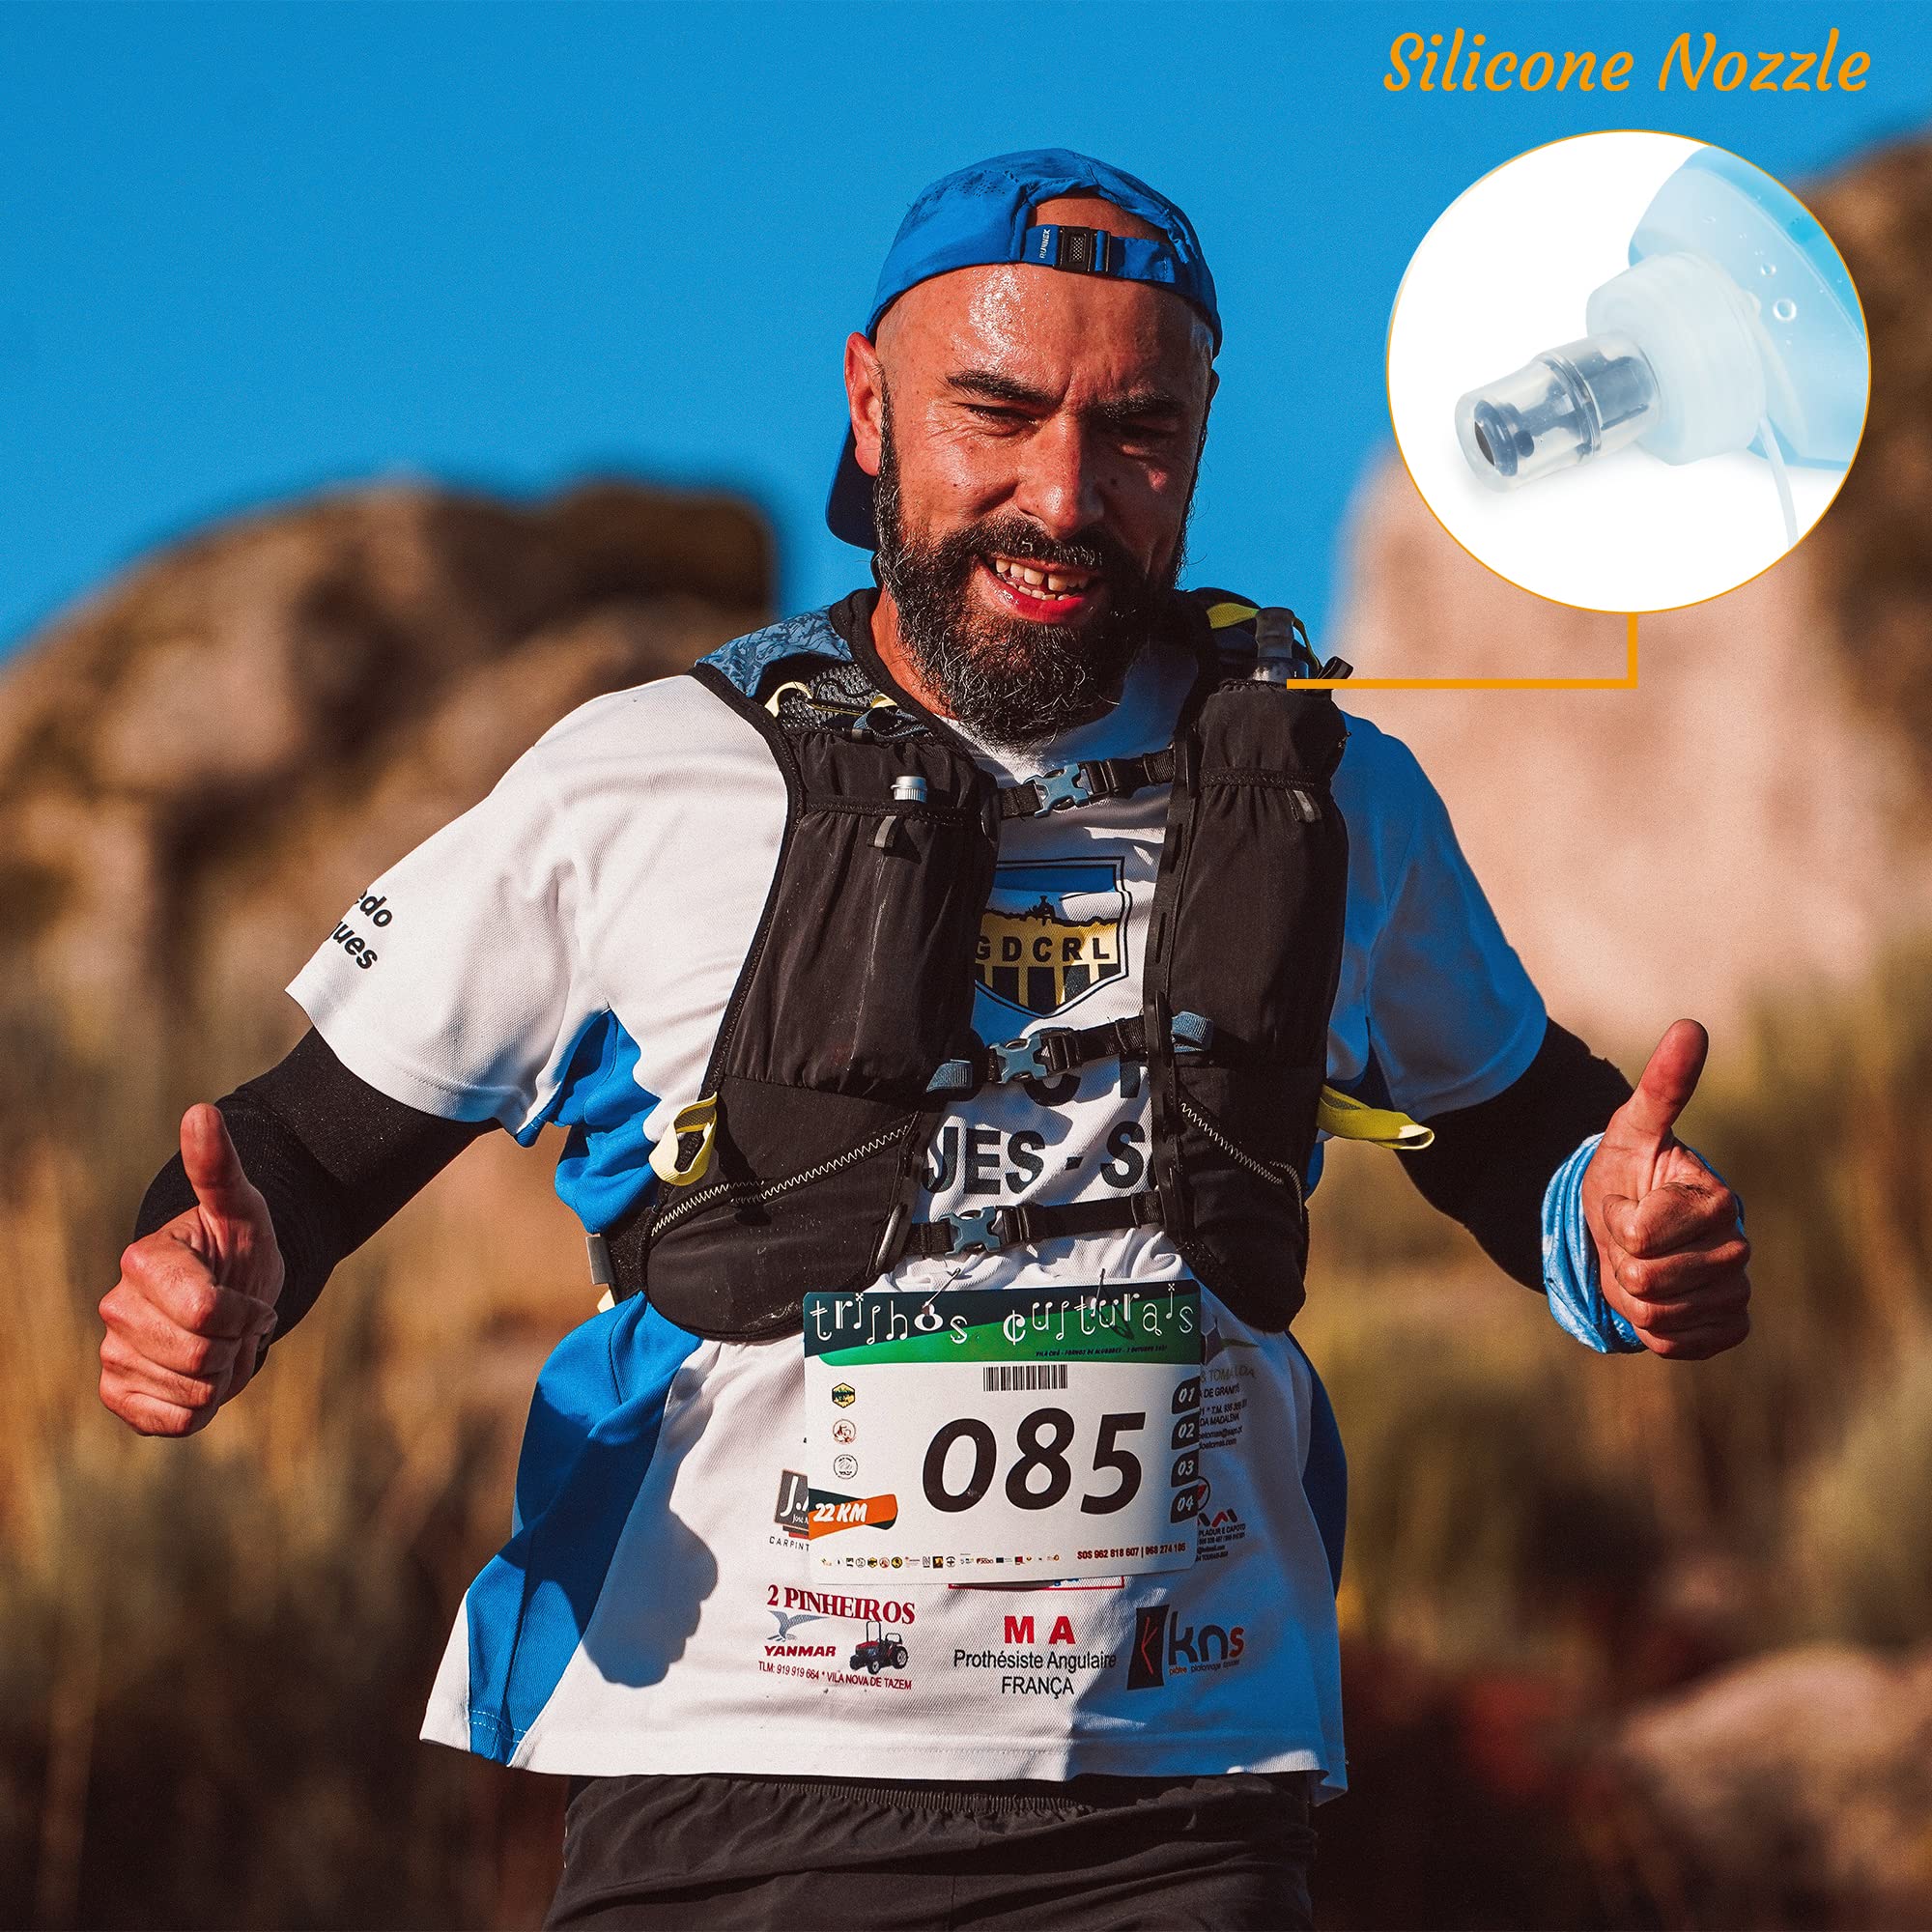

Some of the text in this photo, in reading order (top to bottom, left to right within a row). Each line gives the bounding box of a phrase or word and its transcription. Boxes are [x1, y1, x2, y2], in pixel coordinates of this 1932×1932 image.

[1100, 1121, 1158, 1189] S
[1178, 1386, 1196, 1404] 01
[1178, 1422, 1196, 1439] 02
[923, 1407, 1147, 1516] 085
[1178, 1460, 1195, 1477] 03
[812, 1502, 868, 1523] 22 KM
[1177, 1495, 1195, 1512] 04
[1077, 1549, 1093, 1560] SOS
[1094, 1548, 1109, 1559] 962
[1110, 1548, 1124, 1558] 818
[1125, 1547, 1140, 1557] 607
[1159, 1544, 1173, 1555] 274
[767, 1584, 916, 1625] 2 PINHEIROS
[1004, 1615, 1077, 1645] M A
[1167, 1610, 1245, 1666] kns
[764, 1645, 837, 1658] YANMAR
[953, 1648, 1118, 1675] Prothésiste Angulaire
[776, 1663, 791, 1676] 919
[790, 1665, 805, 1679] 919
[806, 1668, 820, 1681] 664
[827, 1671, 844, 1685] VILA
[845, 1675, 869, 1687] NOVA
[869, 1676, 882, 1689] DE
[883, 1677, 913, 1690] TAZEM
[1001, 1675, 1075, 1700] FRANÇA
